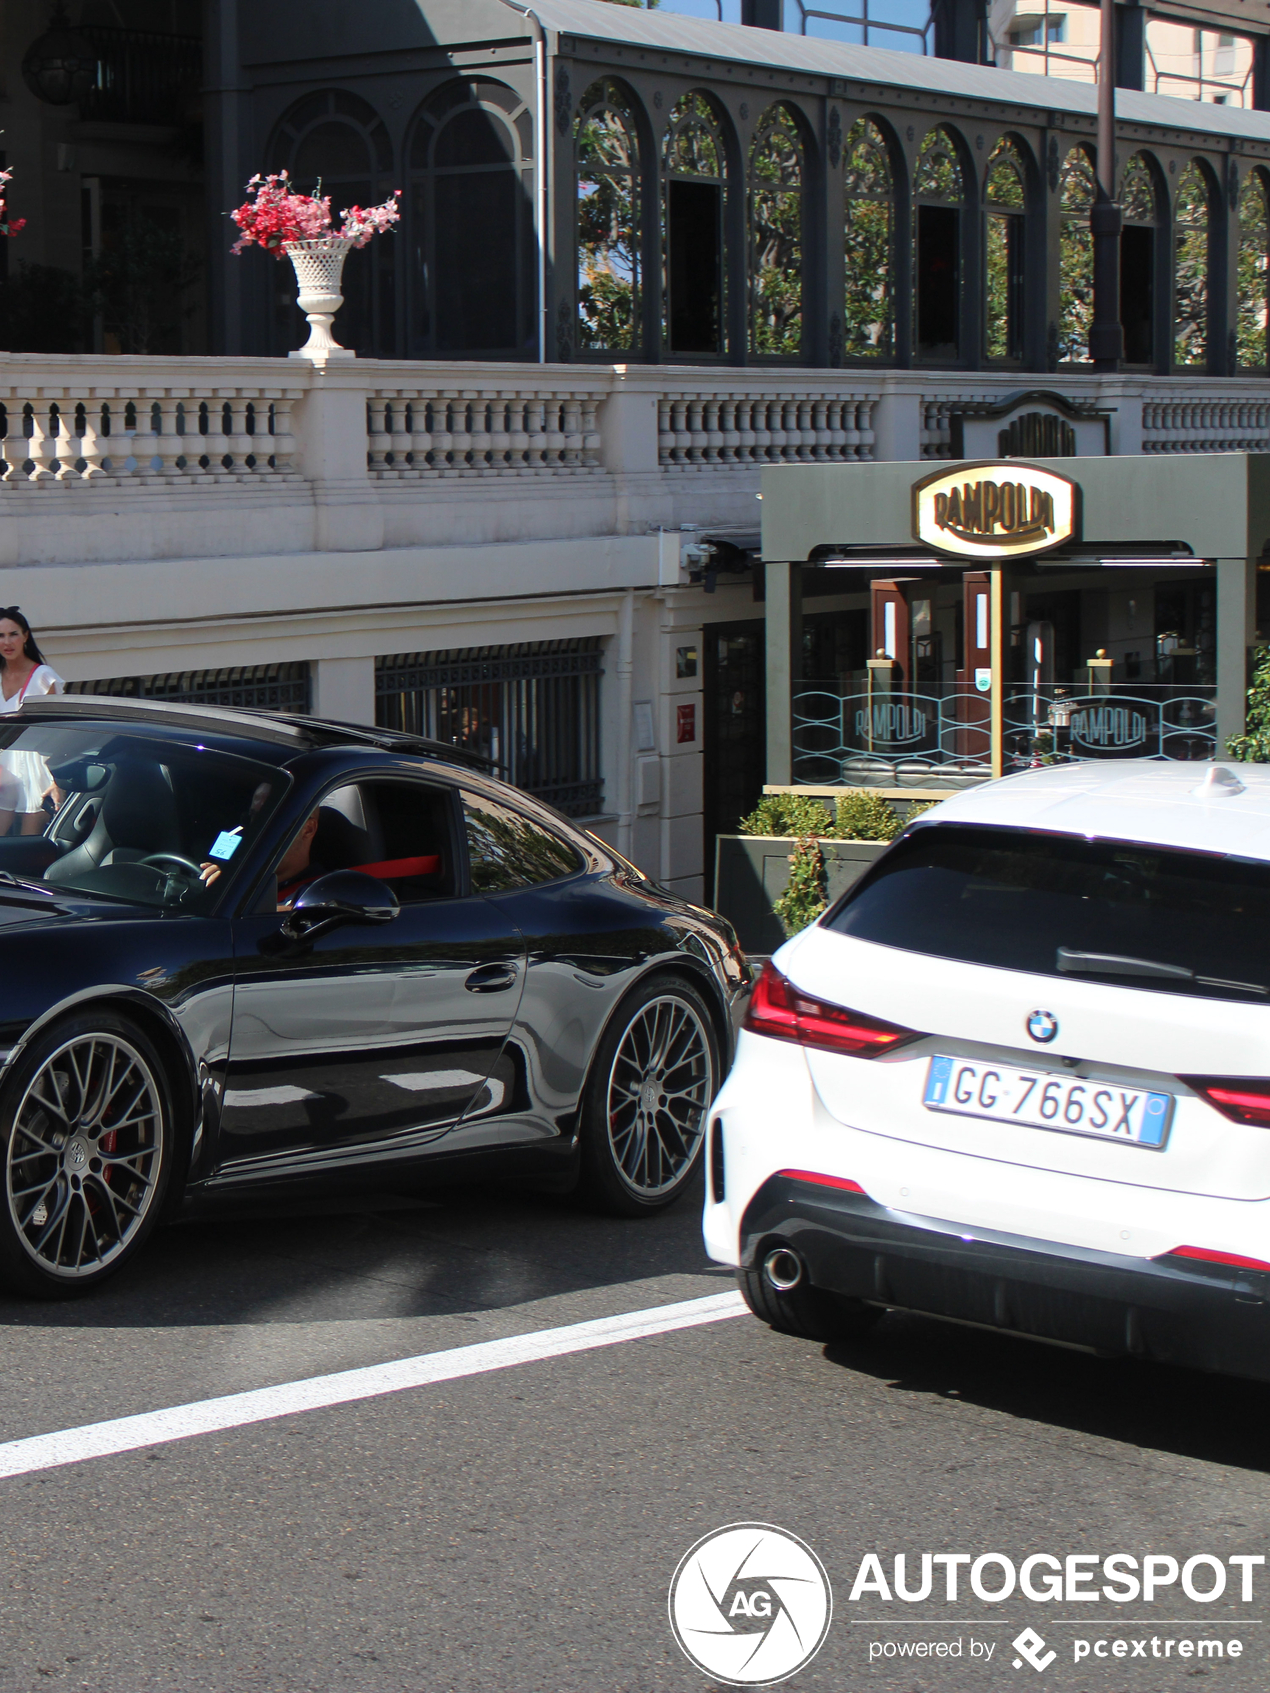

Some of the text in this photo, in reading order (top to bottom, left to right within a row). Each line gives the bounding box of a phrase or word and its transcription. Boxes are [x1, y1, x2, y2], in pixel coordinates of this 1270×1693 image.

[934, 480, 1055, 537] RAMPOLDI
[855, 703, 926, 742] RAMPOLDI
[1070, 707, 1146, 746] RAMPOLDI
